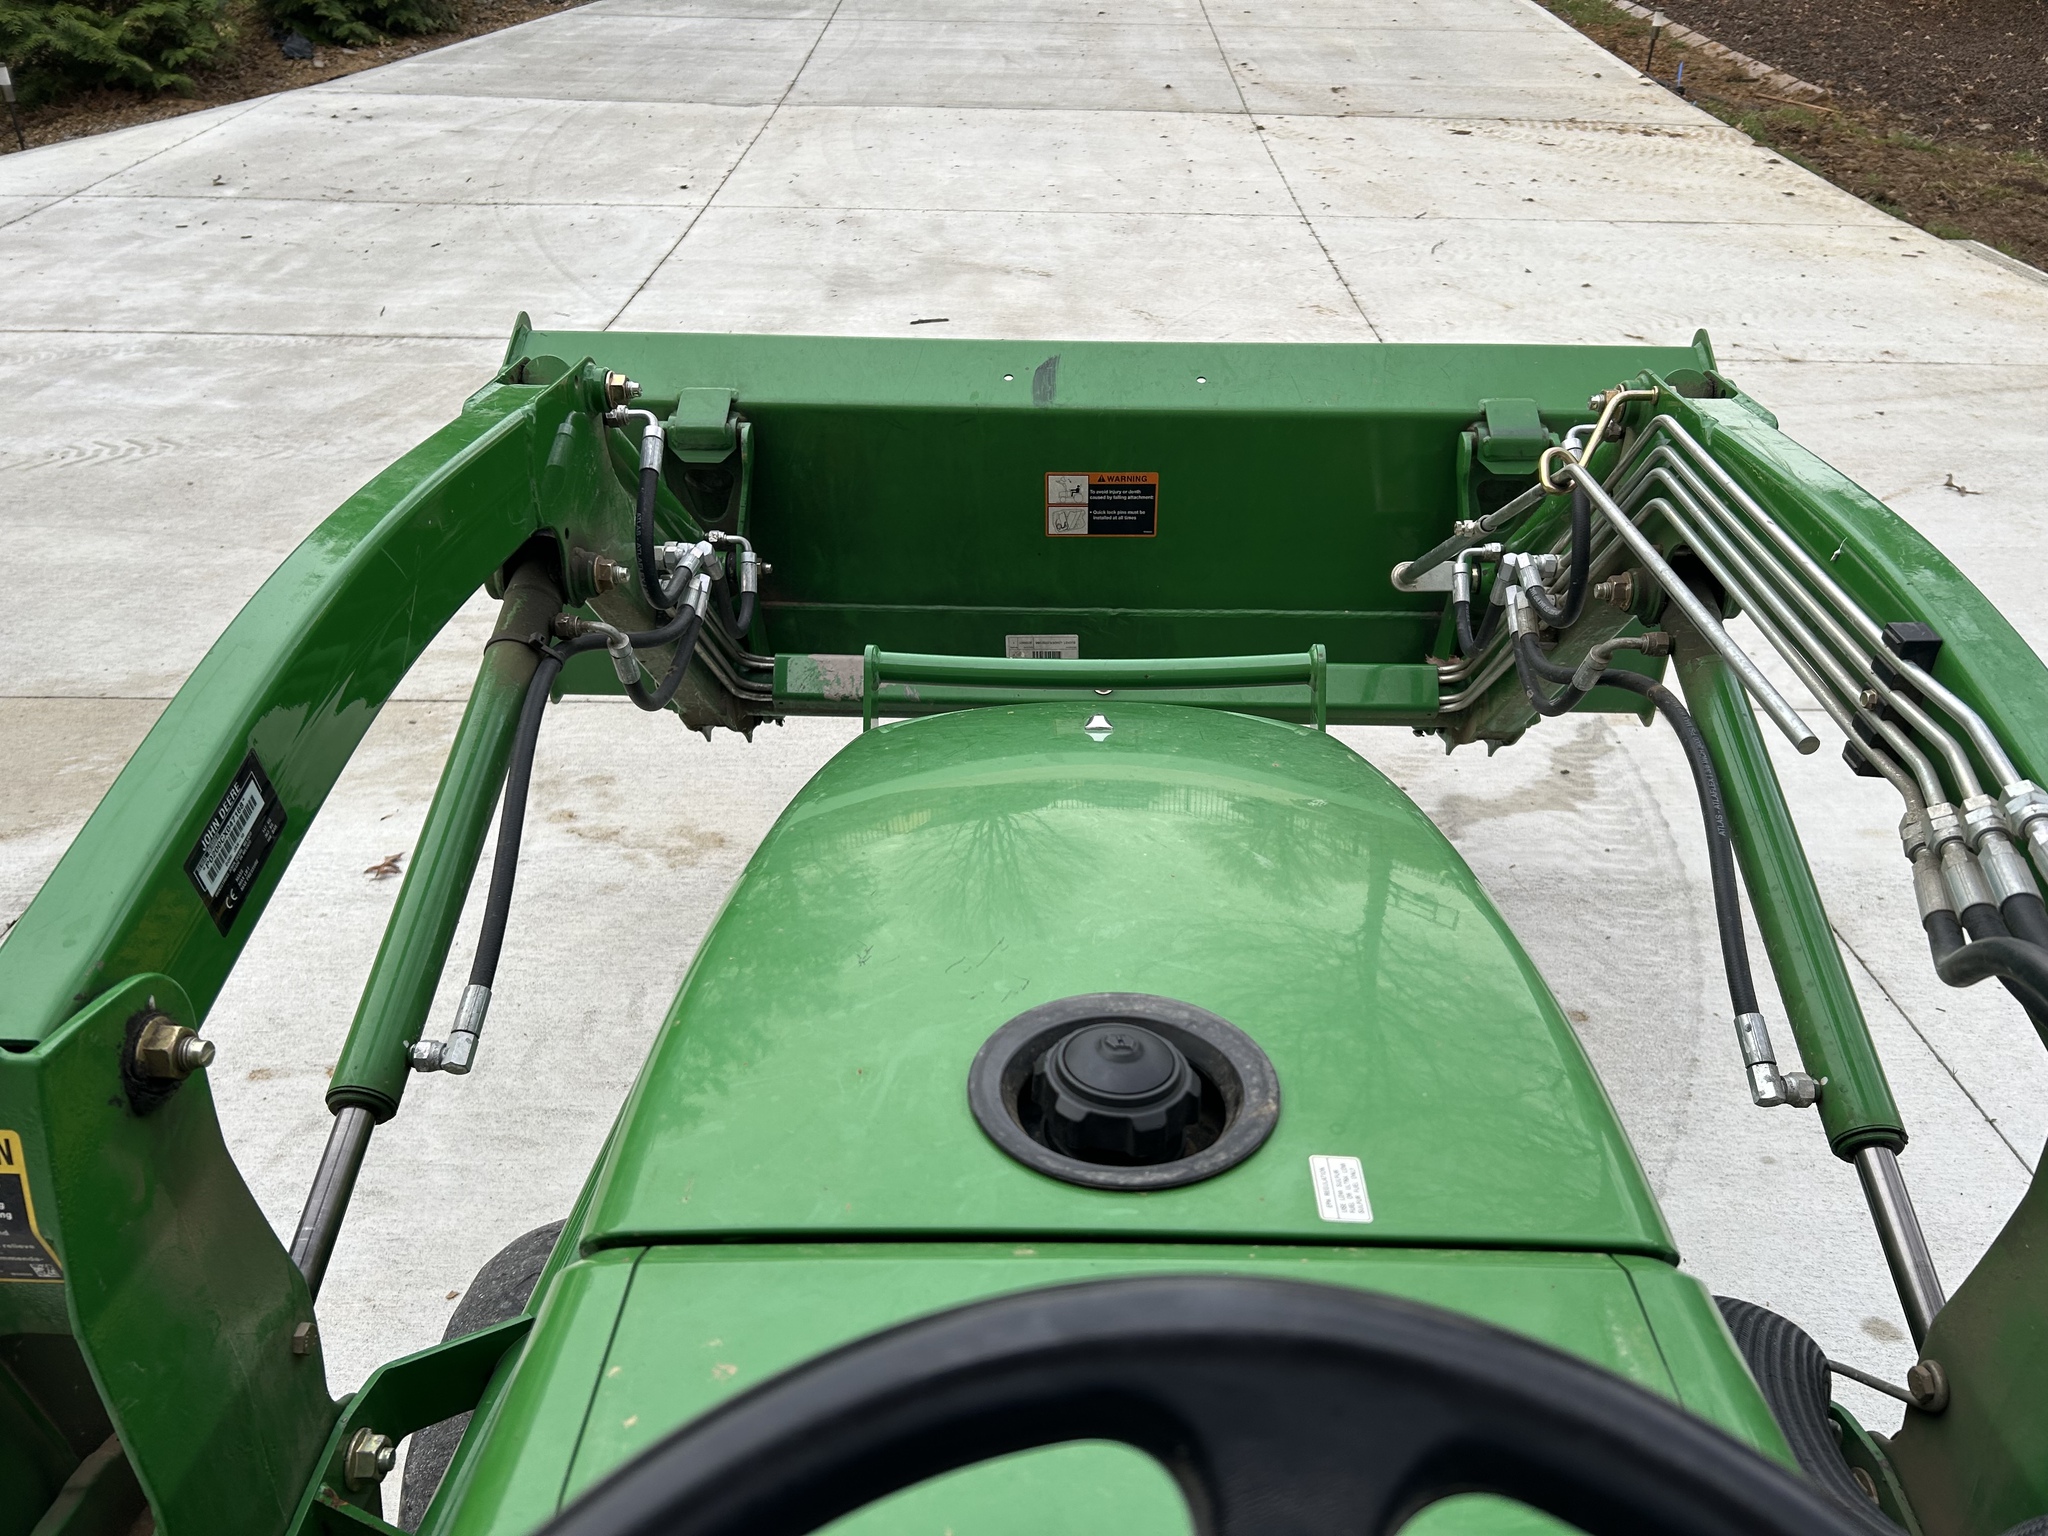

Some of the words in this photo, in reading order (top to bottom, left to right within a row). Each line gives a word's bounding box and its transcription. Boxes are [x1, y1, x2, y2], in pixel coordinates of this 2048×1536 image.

[201, 818, 220, 852] JOHN
[219, 782, 242, 818] DEERE
[1715, 814, 1725, 836] ATLAS
